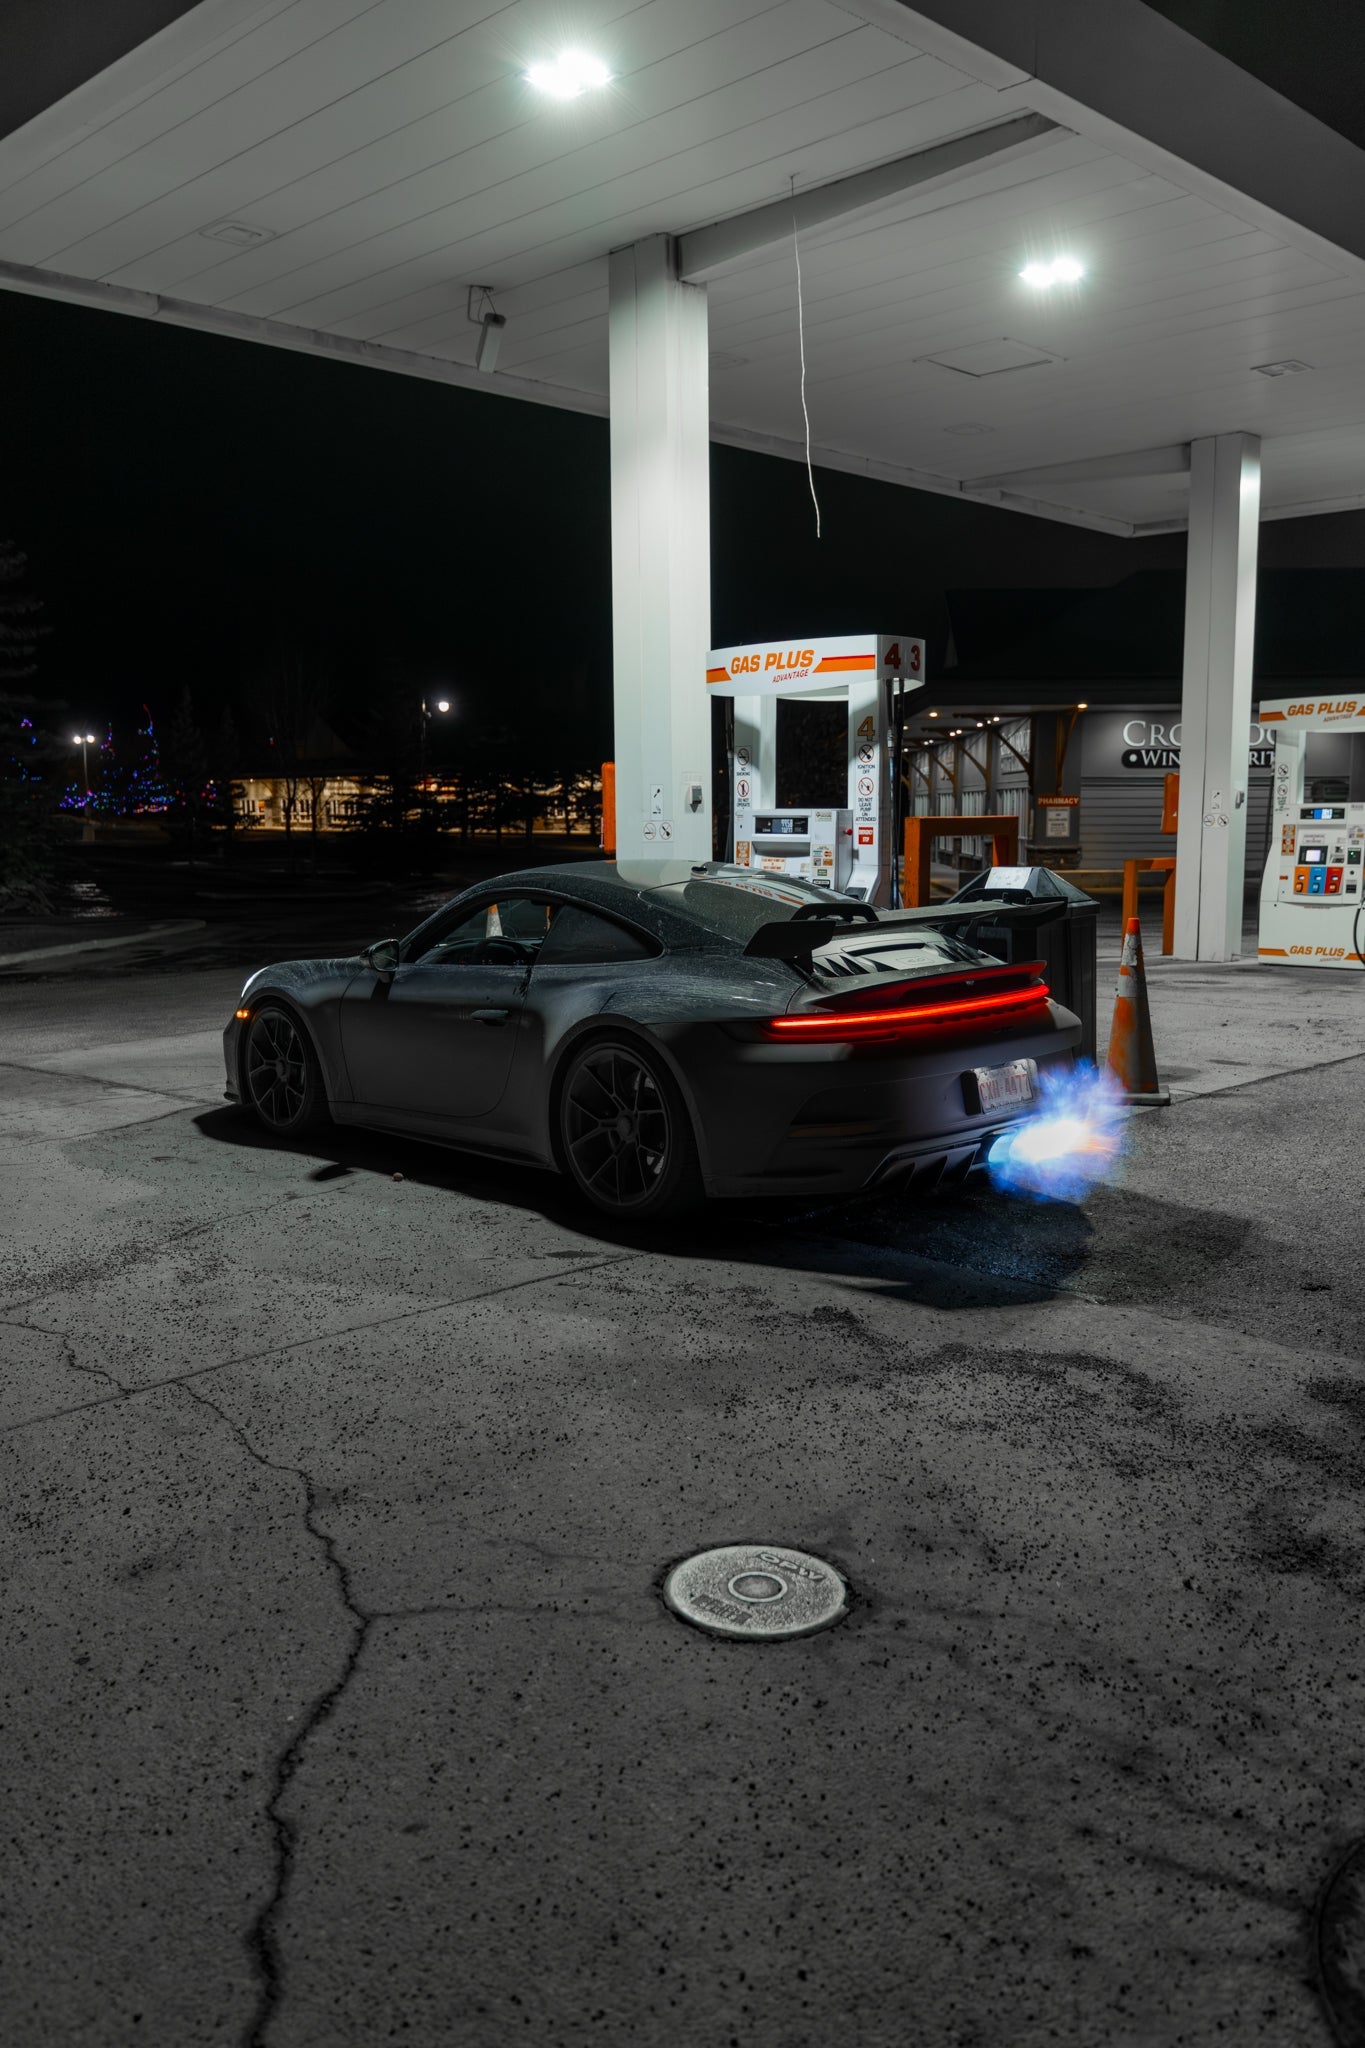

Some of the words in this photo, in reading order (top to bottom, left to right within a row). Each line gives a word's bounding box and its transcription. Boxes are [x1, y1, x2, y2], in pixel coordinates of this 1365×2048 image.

[731, 654, 761, 675] GAS
[764, 650, 815, 671] PLUS
[884, 643, 902, 670] 4
[910, 645, 921, 672] 3
[772, 669, 809, 683] ADVANTAGE
[1287, 703, 1315, 716] GAS
[1317, 701, 1358, 715] PLUS
[857, 716, 876, 741] 4
[1037, 797, 1079, 805] PHARMACY
[1289, 945, 1313, 955] GAS
[1315, 946, 1345, 957] PLUS
[760, 1552, 825, 1581] OPW
